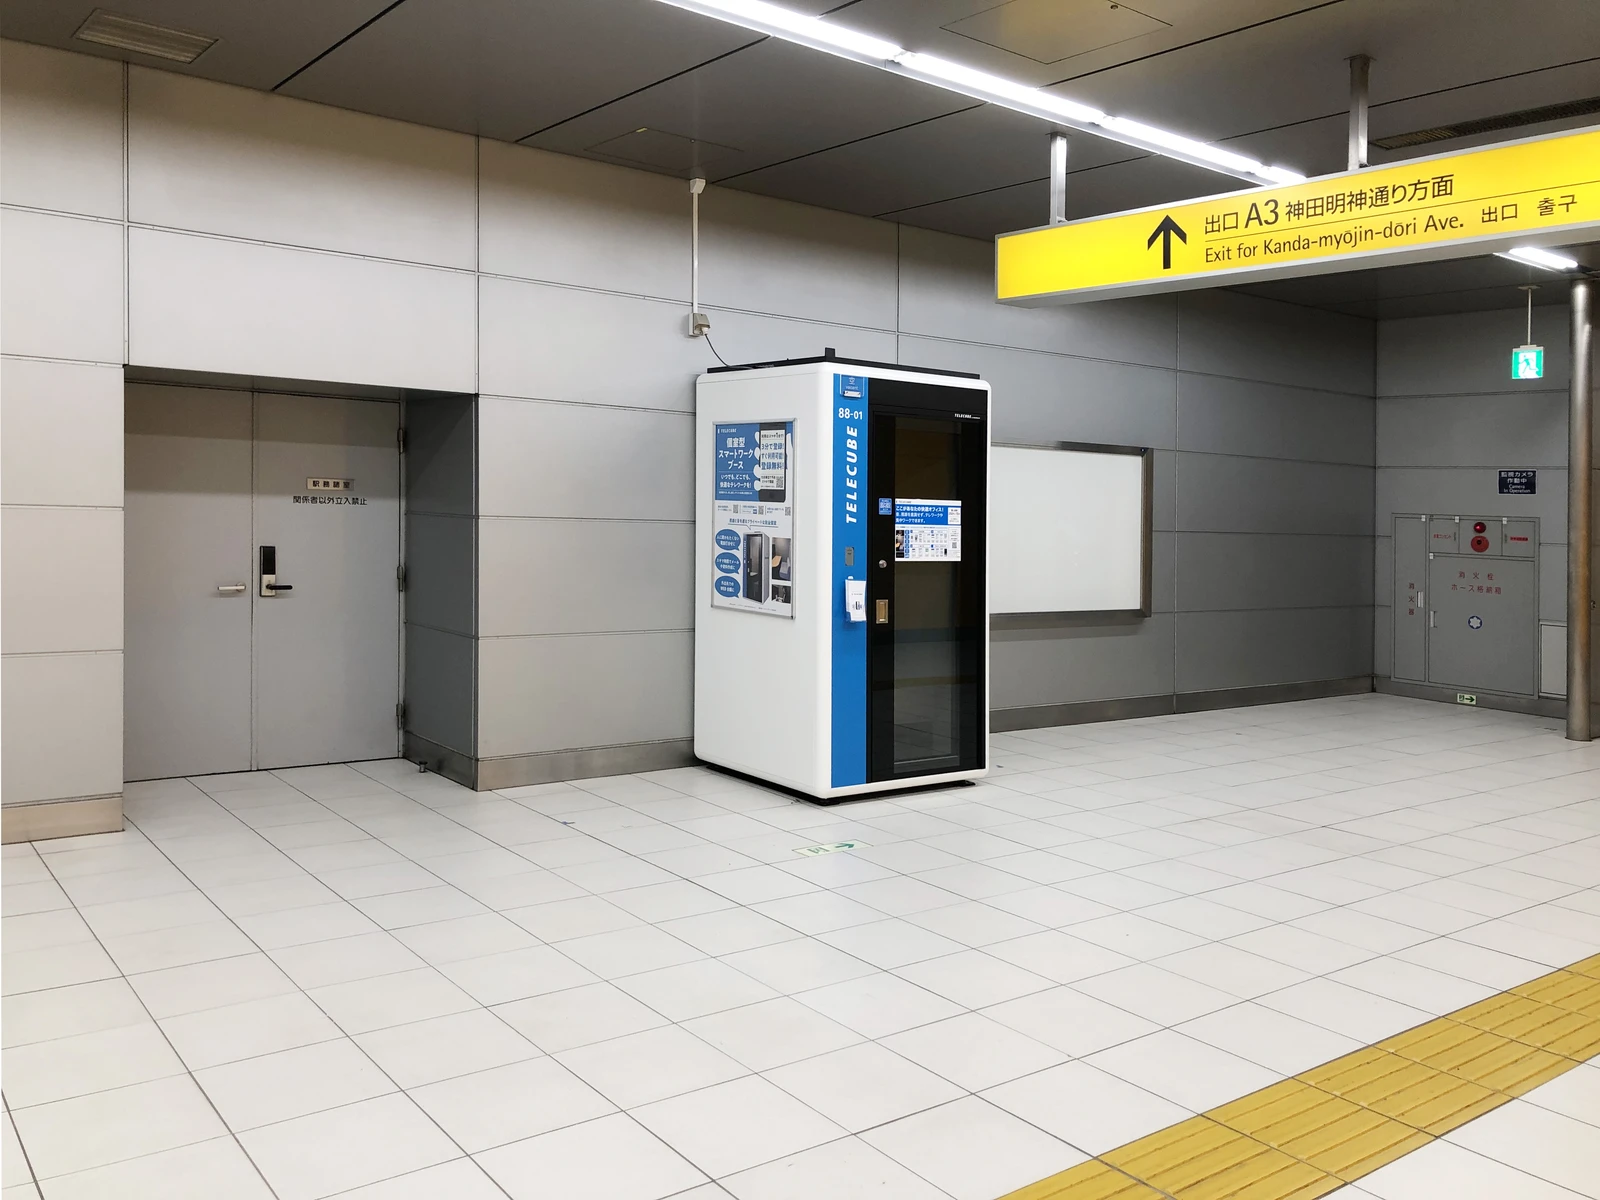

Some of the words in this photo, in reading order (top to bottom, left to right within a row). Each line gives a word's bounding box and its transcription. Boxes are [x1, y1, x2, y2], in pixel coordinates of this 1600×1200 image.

[1204, 214, 1240, 236] 出口
[1244, 198, 1280, 228] A3
[1284, 174, 1455, 223] 神田明神通り方面
[1480, 202, 1520, 225] 出口
[1536, 193, 1579, 217] 출구
[1204, 244, 1233, 264] Exit
[1235, 241, 1259, 261] for
[1262, 217, 1419, 254] Kanda-myōjin-dōri
[1423, 214, 1465, 234] Ave.
[838, 407, 863, 420] 88-01
[726, 437, 746, 448] 個室型
[718, 448, 754, 459] スマートワーク
[727, 459, 744, 470] ブース
[845, 425, 859, 524] TELECUBE
[292, 495, 368, 506] 関係者以外立入禁止
